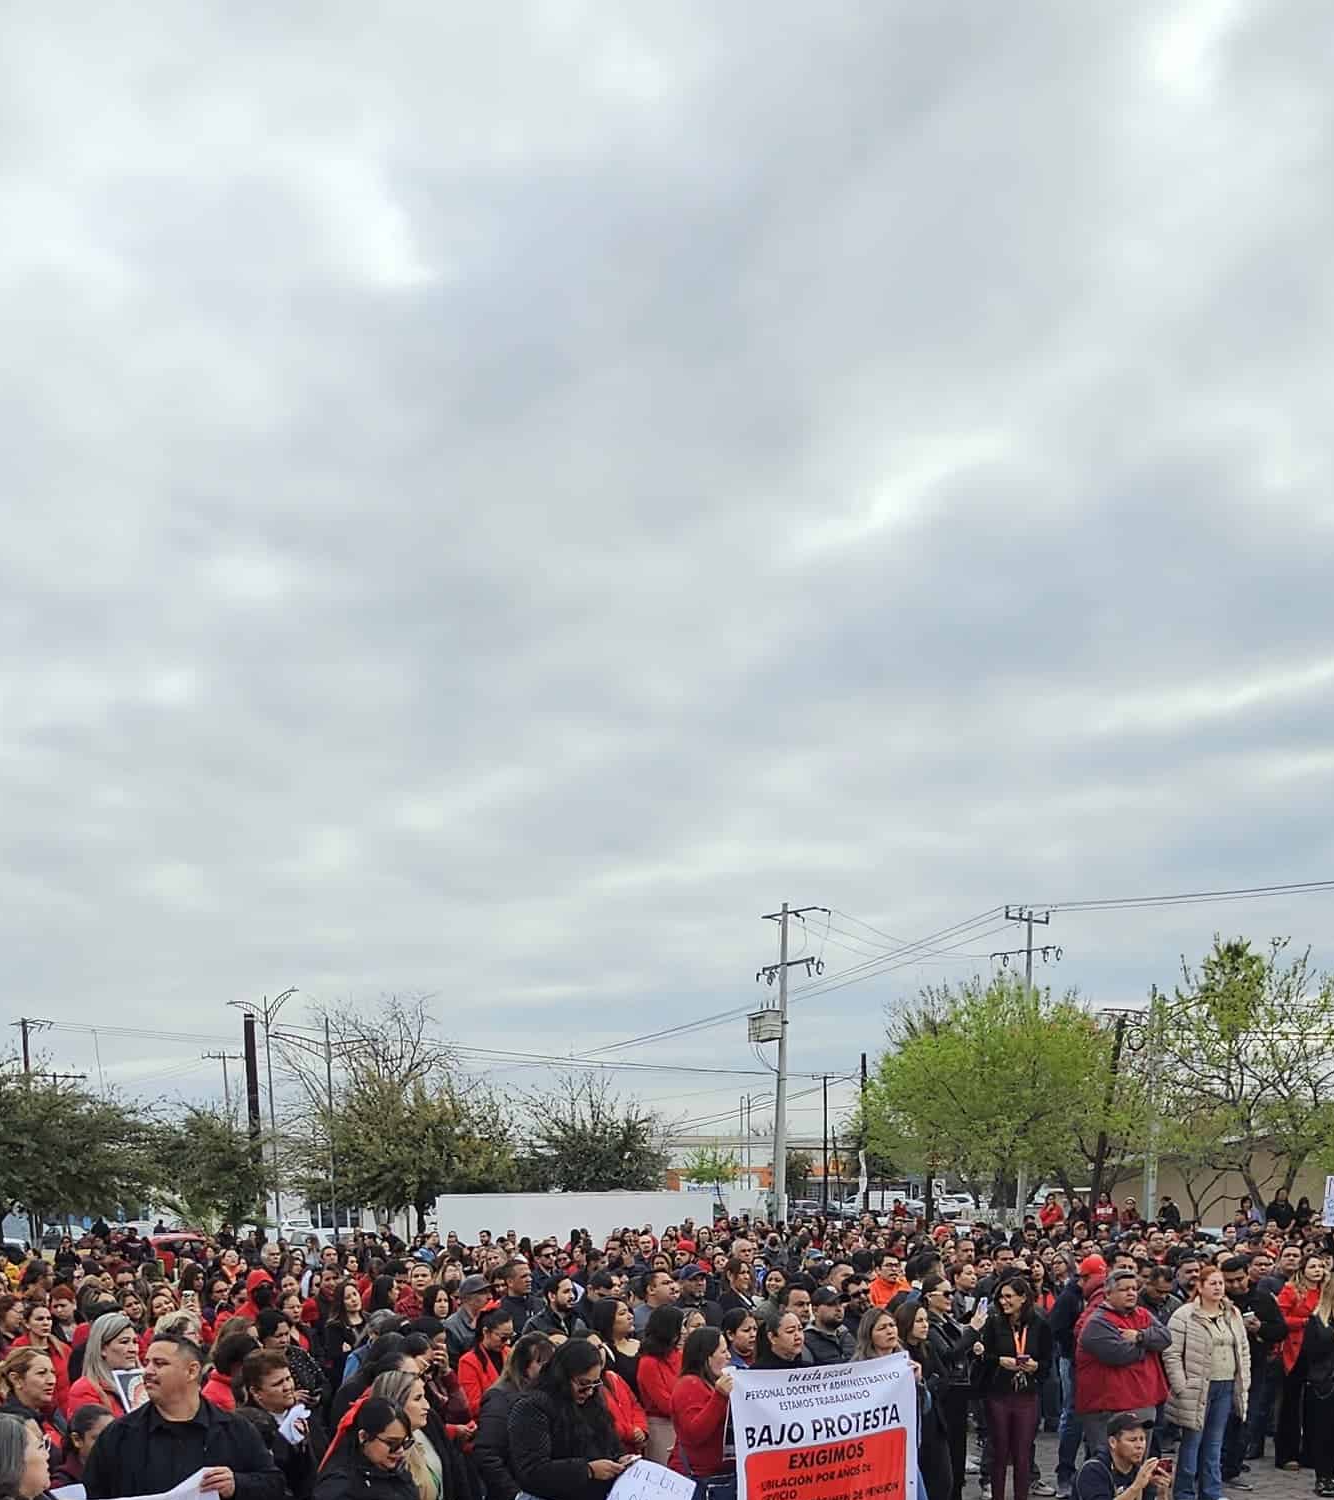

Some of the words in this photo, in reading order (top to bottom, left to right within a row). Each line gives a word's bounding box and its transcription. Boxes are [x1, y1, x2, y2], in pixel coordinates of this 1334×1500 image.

[745, 1388, 785, 1401] PERSONAL
[786, 1384, 821, 1397] DOCENTE
[829, 1371, 901, 1391] ADMINISTRATIVO
[779, 1400, 815, 1411] ESTAMOS
[816, 1389, 871, 1407] TRABAJANDO
[745, 1422, 804, 1449] BAJO
[811, 1403, 901, 1441] PROTESTA
[788, 1441, 865, 1470] EXIGIMOS
